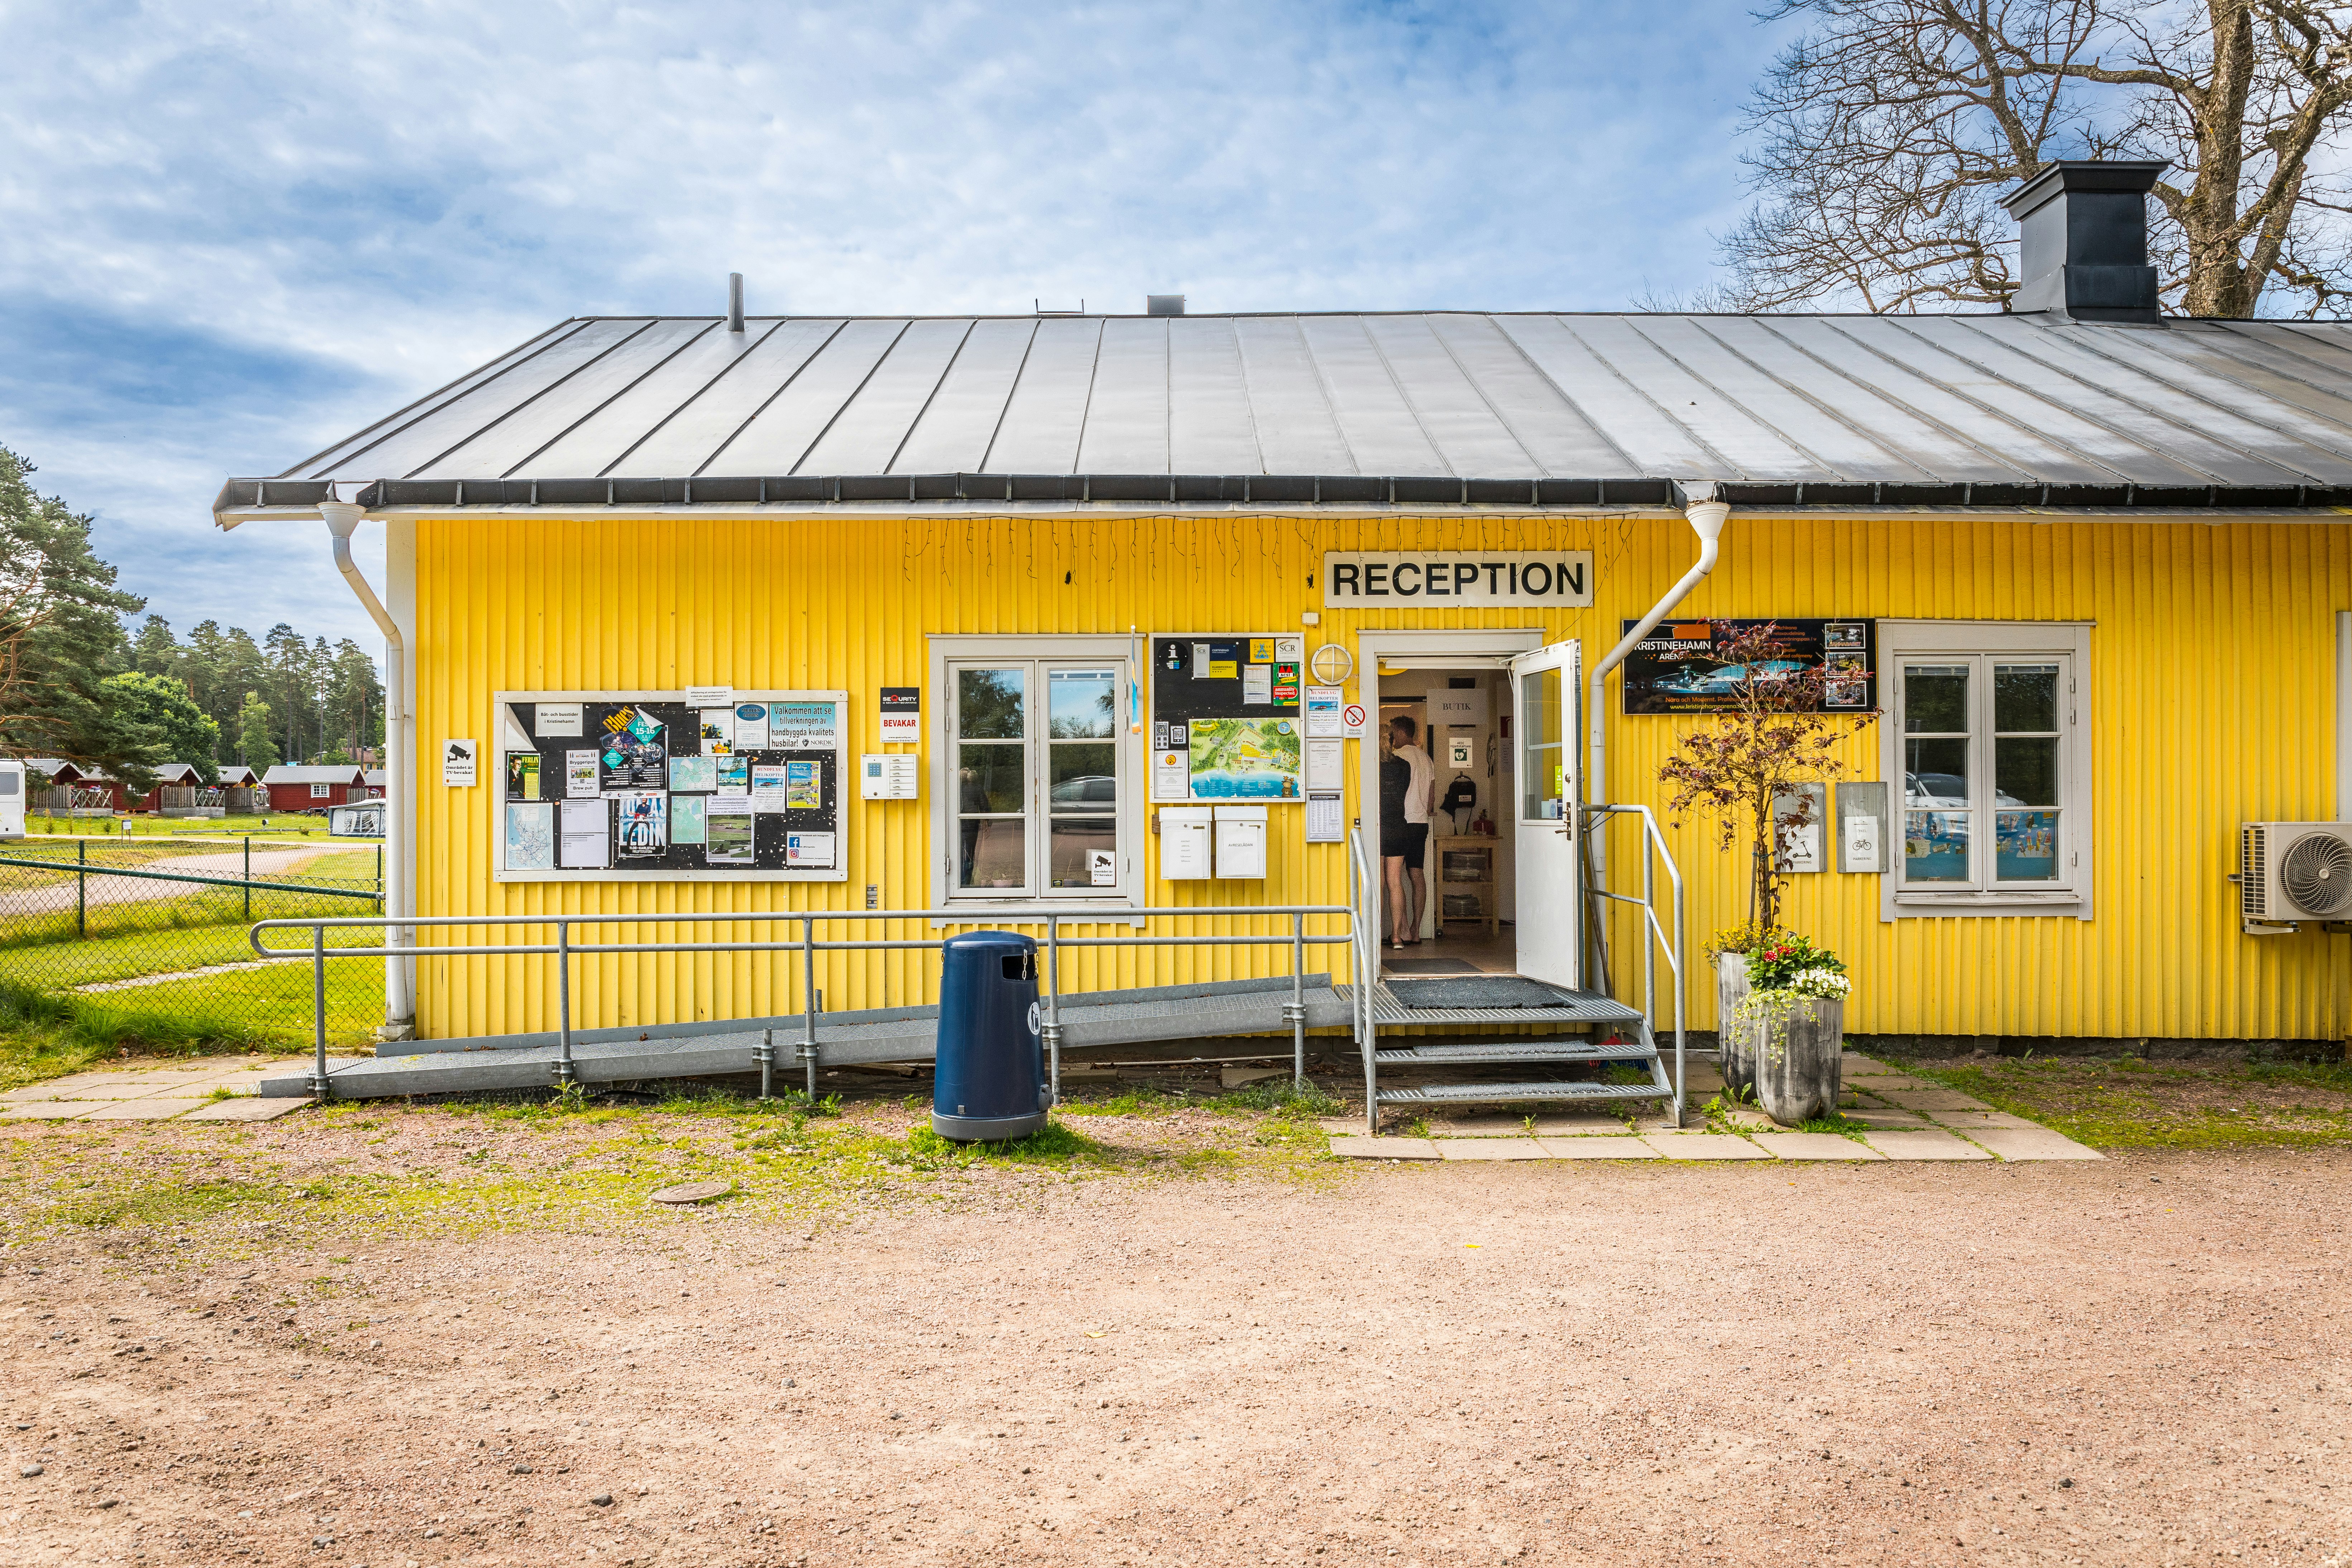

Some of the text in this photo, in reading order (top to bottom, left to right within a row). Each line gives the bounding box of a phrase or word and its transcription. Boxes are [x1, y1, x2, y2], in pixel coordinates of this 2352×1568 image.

[1333, 562, 1584, 596] RECEPTION
[603, 705, 634, 733] Blues
[774, 706, 811, 715] Välkommen
[813, 706, 822, 715] att
[780, 716, 818, 726] tillverkningen
[772, 728, 807, 738] handbyggda
[808, 728, 834, 736] kvalitéts
[620, 798, 666, 817] TOAS
[619, 823, 666, 846] LEDIN
